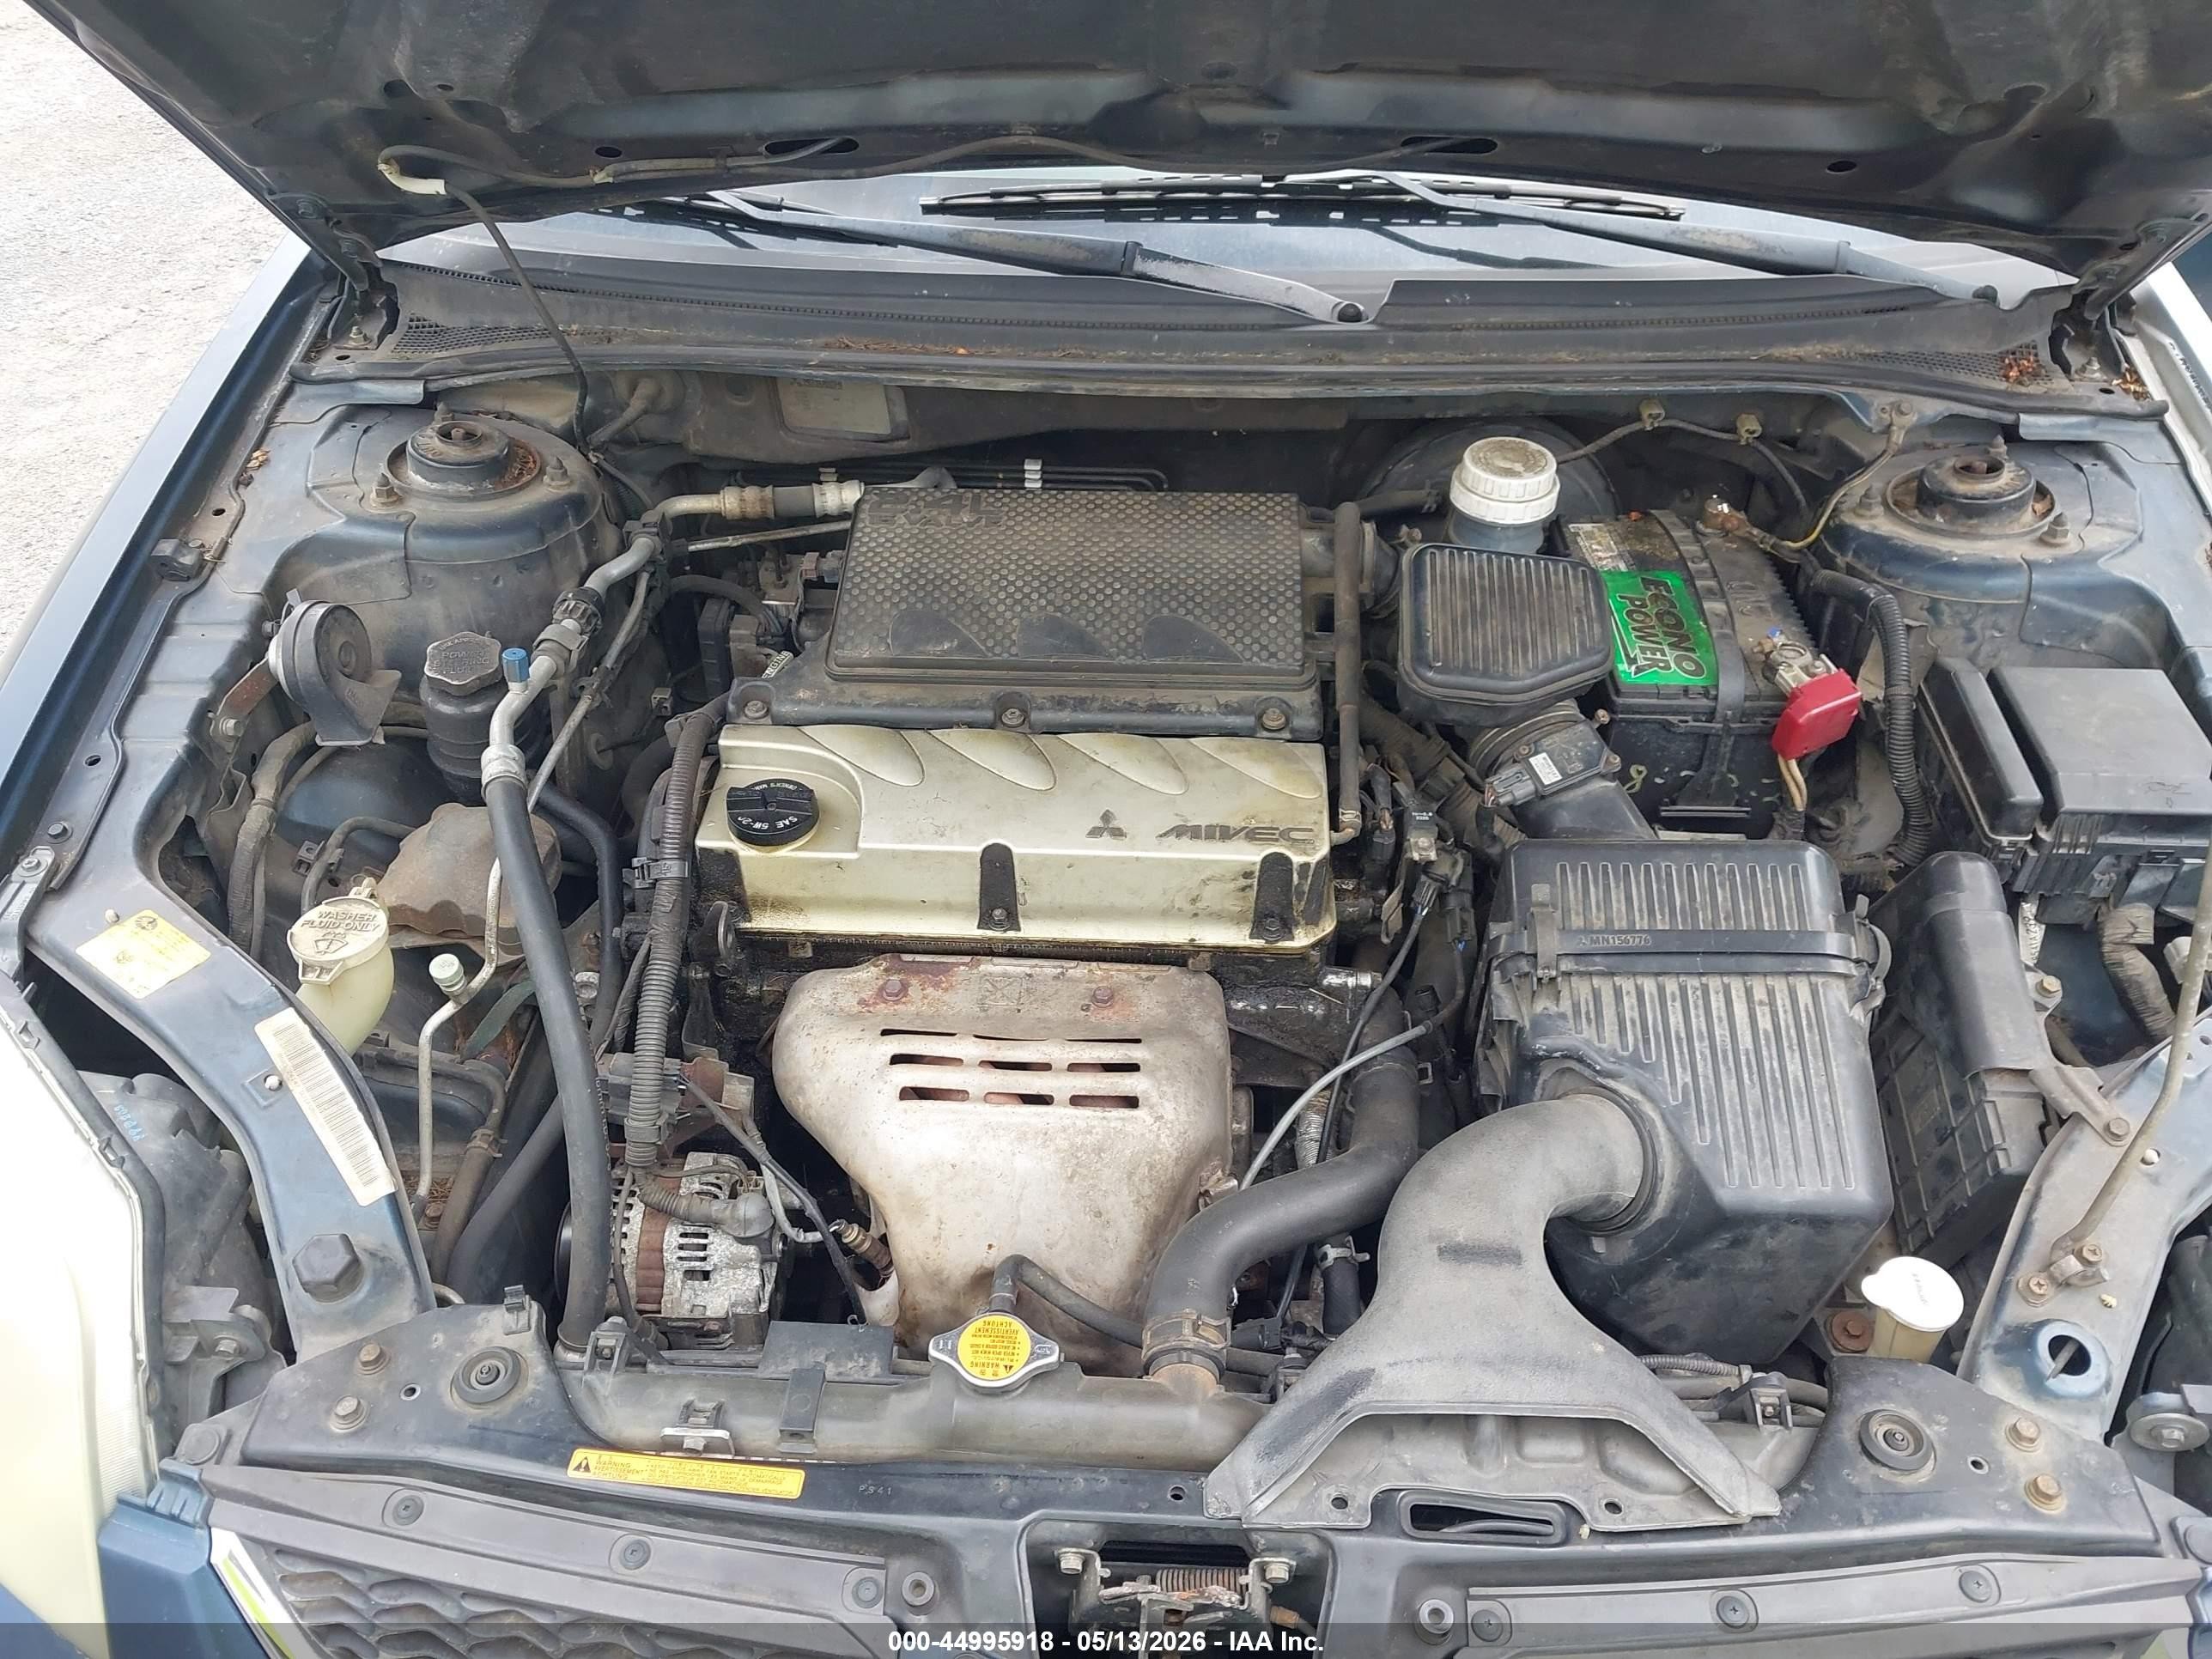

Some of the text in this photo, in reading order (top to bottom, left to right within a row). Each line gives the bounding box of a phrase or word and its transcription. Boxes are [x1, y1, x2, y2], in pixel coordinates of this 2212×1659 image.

[1639, 576, 1706, 679] ECONO
[1616, 593, 1674, 678] POWER
[775, 817, 798, 829] SAE
[1156, 824, 1315, 845] MIVEC
[319, 911, 377, 921] WASHER
[301, 920, 380, 932] FLUID ONLY
[594, 1465, 644, 1474] AVERTISSEMENT
[596, 1460, 631, 1468] WARNING
[592, 1471, 628, 1480] ACHTUNG
